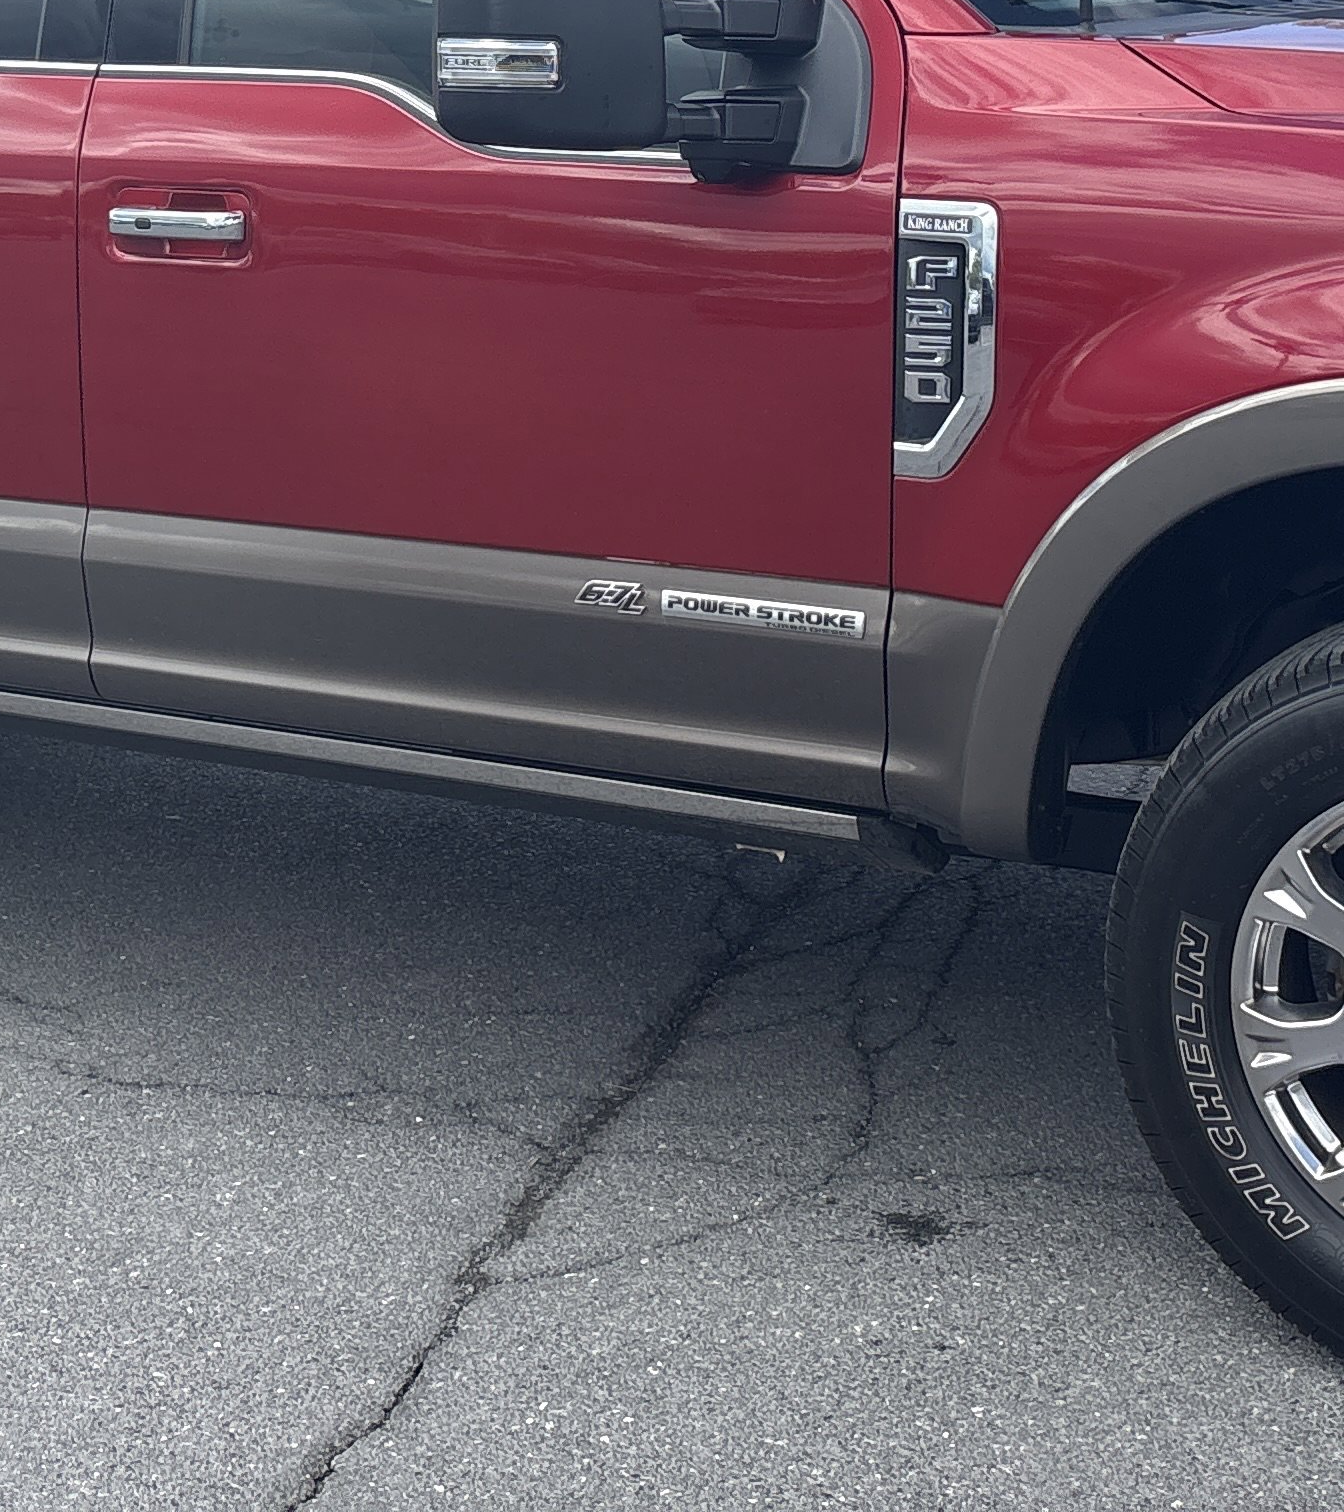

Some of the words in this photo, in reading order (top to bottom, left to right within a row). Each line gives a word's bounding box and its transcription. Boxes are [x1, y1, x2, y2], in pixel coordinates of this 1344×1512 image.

[907, 214, 933, 230] KING
[933, 218, 969, 233] RANCH
[667, 595, 750, 617] POWER
[757, 605, 856, 629] STROKE
[1175, 921, 1310, 1240] MICHELIN
